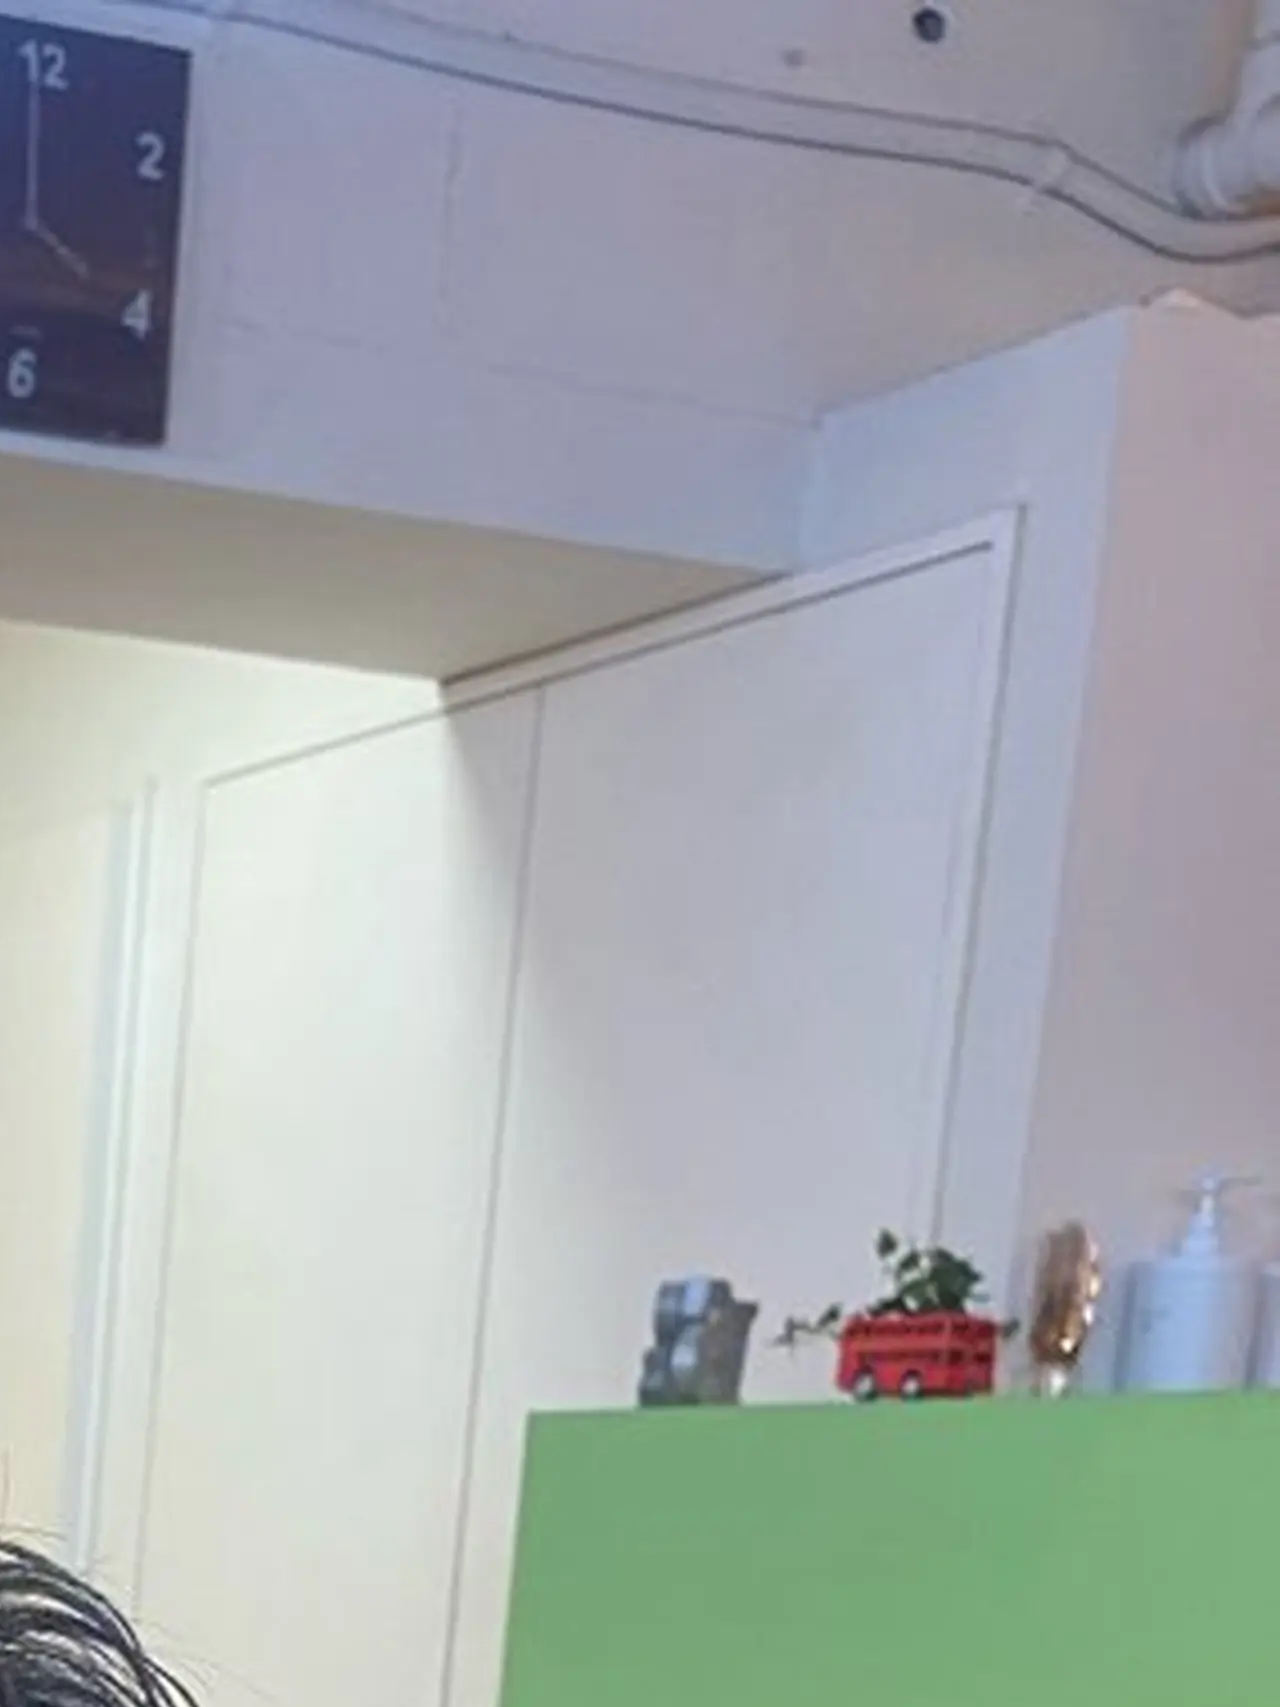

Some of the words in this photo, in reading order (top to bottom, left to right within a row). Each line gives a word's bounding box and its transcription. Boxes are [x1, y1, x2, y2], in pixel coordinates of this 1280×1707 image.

[17, 40, 69, 90] 12
[136, 132, 166, 180] 2
[122, 289, 153, 339] 4
[6, 347, 36, 399] 6
